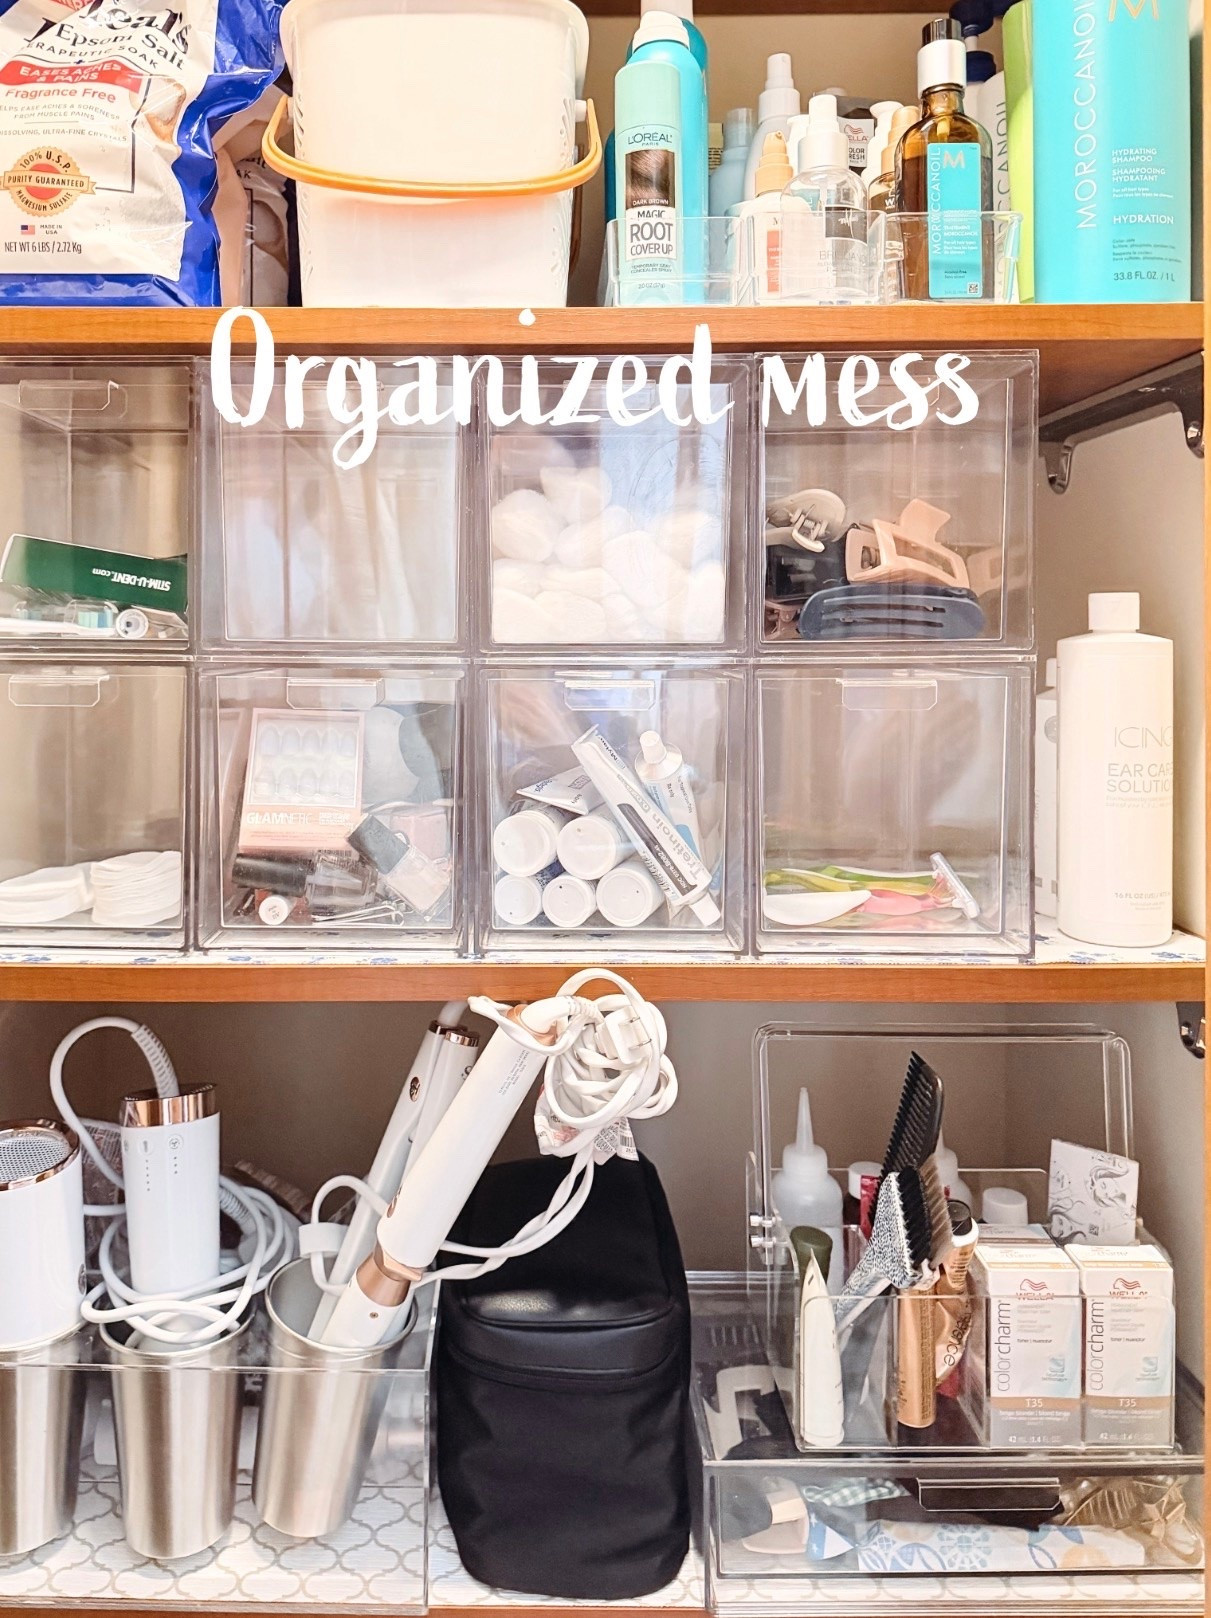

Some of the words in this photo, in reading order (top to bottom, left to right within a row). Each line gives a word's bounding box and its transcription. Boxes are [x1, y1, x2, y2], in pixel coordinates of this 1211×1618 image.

[26, 41, 112, 57] ERAPEUTIC
[118, 45, 158, 69] SOAK
[141, 33, 185, 71] Salt
[19, 66, 69, 77] EASES
[73, 61, 122, 75] ACHES
[53, 73, 98, 82] PAINS
[5, 88, 78, 100] Fragrance
[82, 88, 116, 103] Free
[70, 111, 95, 120] PAINS
[1073, 0, 1097, 229] MOROCCANOI
[1112, 148, 1157, 157] HYDRATING
[20, 151, 42, 168] 100%
[1112, 155, 1153, 164] SHAMPOO
[1112, 168, 1166, 176] SHAMPOOING
[1112, 174, 1158, 183] HYDRATANT
[8, 175, 32, 183] PURITY
[35, 175, 84, 188] GUARANTEED
[16, 189, 47, 211] MAGNESIUM
[49, 192, 73, 210] SULFATE
[637, 210, 666, 218] MAGIC
[1113, 214, 1174, 224] HYDRATION
[630, 222, 673, 243] ROOT
[4, 242, 17, 252] NET
[20, 242, 30, 252] WT
[38, 242, 50, 252] LBS
[56, 242, 71, 252] 2.72
[72, 242, 82, 254] Kg
[630, 243, 660, 256] COVER
[662, 243, 673, 254] UP
[1114, 271, 1133, 281] 33.8
[1108, 763, 1143, 777] EAR
[1107, 779, 1170, 793] SOLUTIO
[652, 813, 700, 880] Tretinoin
[994, 1302, 1011, 1392] colorcharm
[1087, 1302, 1104, 1391] colorcharm
[1025, 1398, 1043, 1408] T35
[1118, 1398, 1137, 1407] T35
